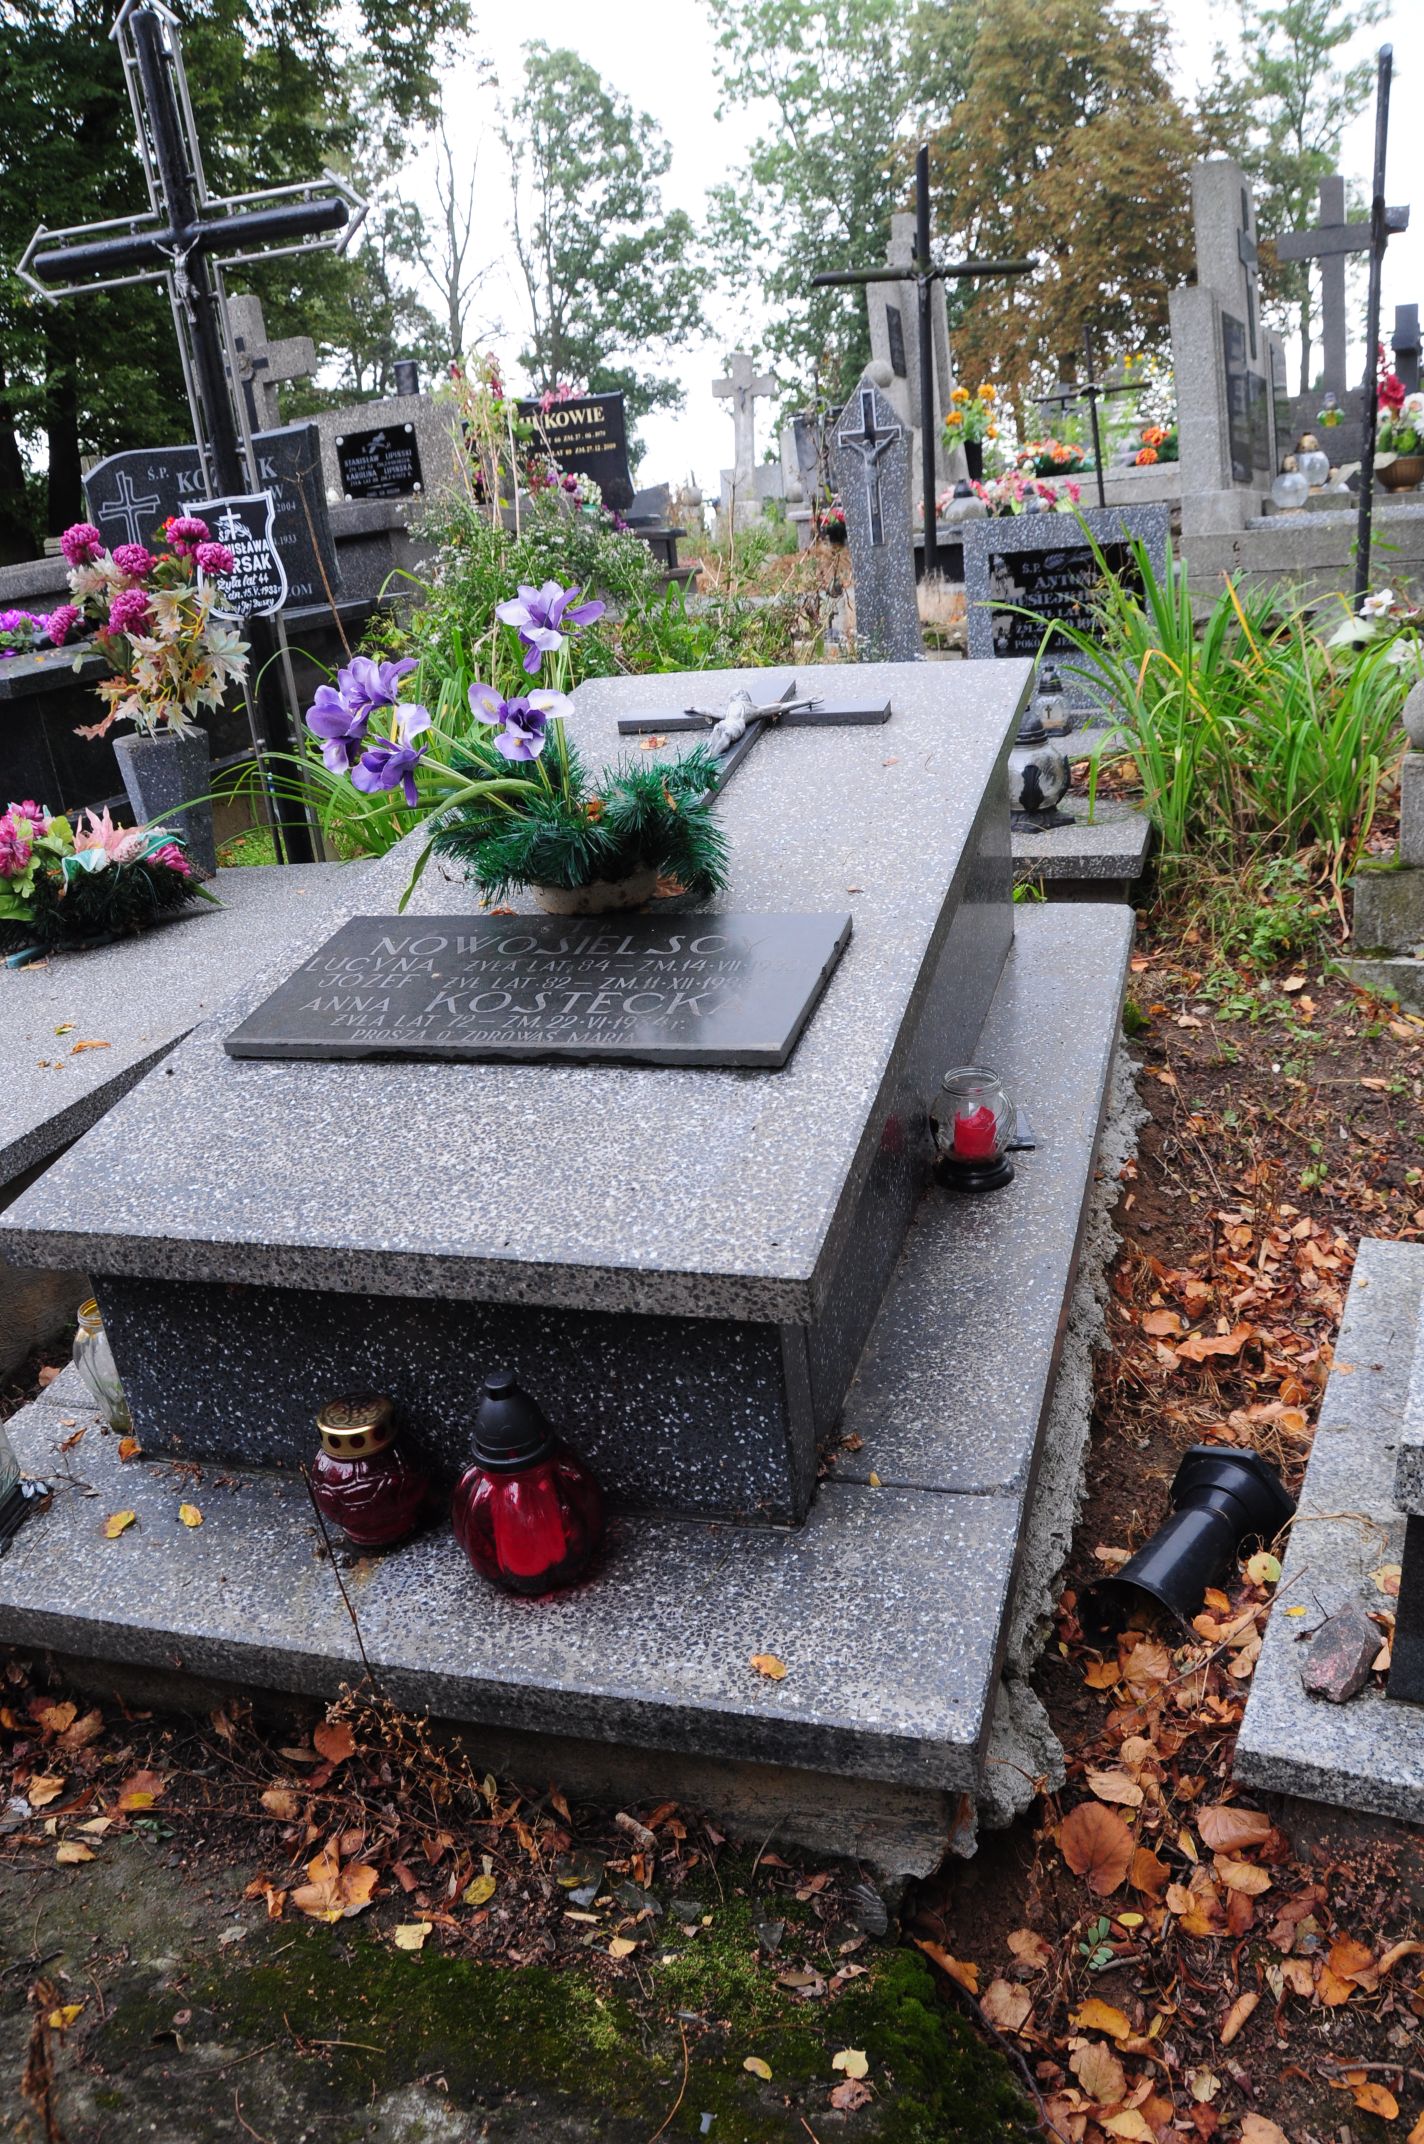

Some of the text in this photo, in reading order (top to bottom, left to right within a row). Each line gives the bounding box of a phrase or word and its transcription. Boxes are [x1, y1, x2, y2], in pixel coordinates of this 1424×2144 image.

[370, 935, 774, 956] NOWOSIELSCY
[303, 957, 434, 972] LUCYNA
[577, 959, 612, 972] 84
[317, 971, 421, 989] JÓZEF
[298, 990, 745, 1017] ANNA KOSTECKA
[394, 1014, 442, 1027] LAT
[448, 1014, 477, 1028] 72
